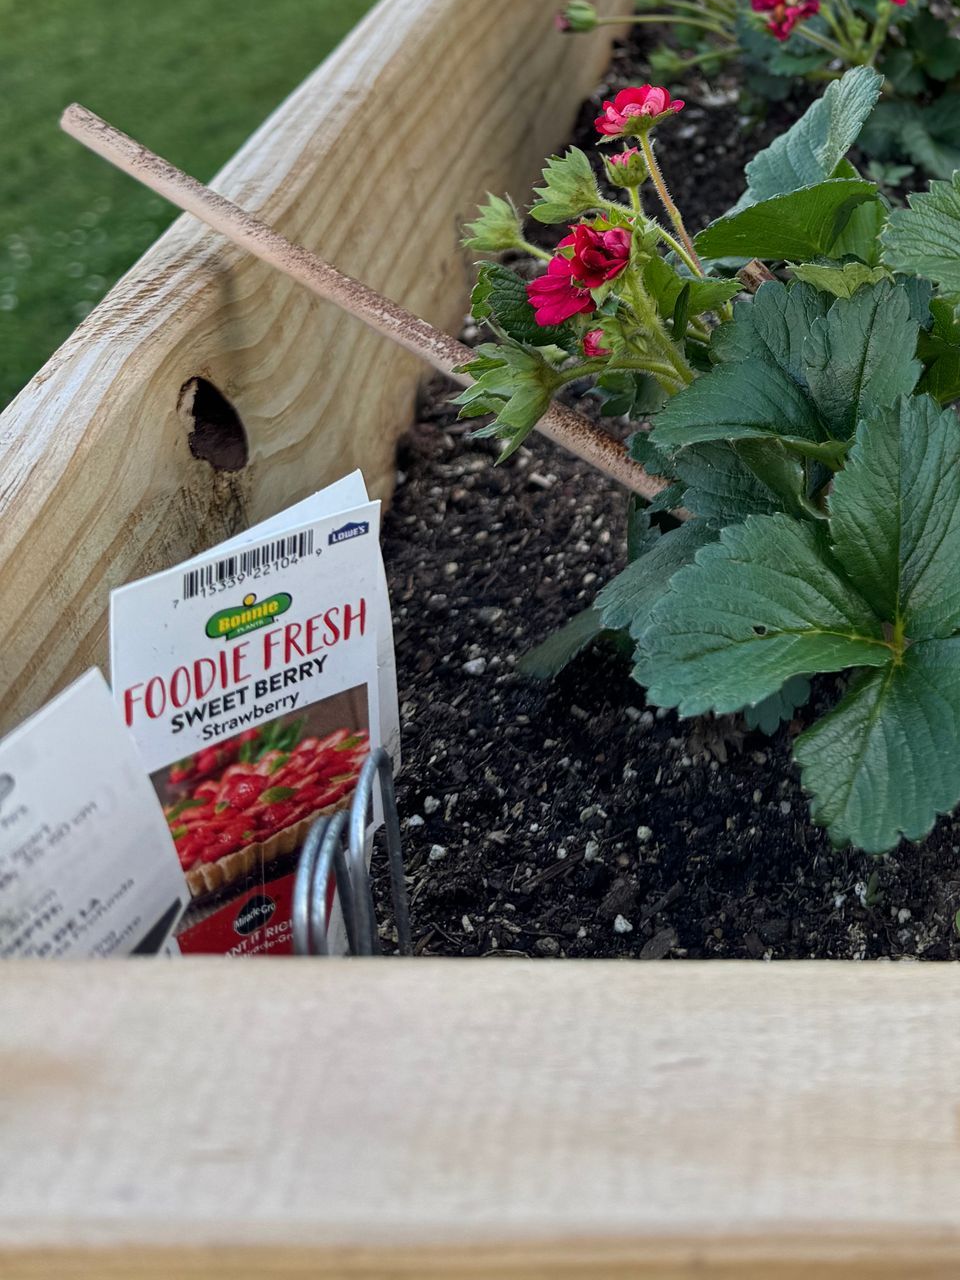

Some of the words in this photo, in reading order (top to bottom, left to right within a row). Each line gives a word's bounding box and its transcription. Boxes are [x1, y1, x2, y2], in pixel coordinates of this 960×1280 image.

[332, 525, 366, 543] LOWE'S
[173, 599, 180, 609] 7
[200, 573, 246, 599] 15339
[253, 556, 299, 580] 22104
[315, 548, 323, 557] 9
[218, 599, 279, 633] Bonnie
[123, 640, 253, 728] FOODIE
[263, 597, 368, 672] FRESH
[171, 685, 248, 734] SWEET
[255, 654, 329, 700] BERRY
[202, 691, 300, 742] Strawberry
[234, 902, 276, 929] Miracle-Gro
[250, 930, 262, 944] IT
